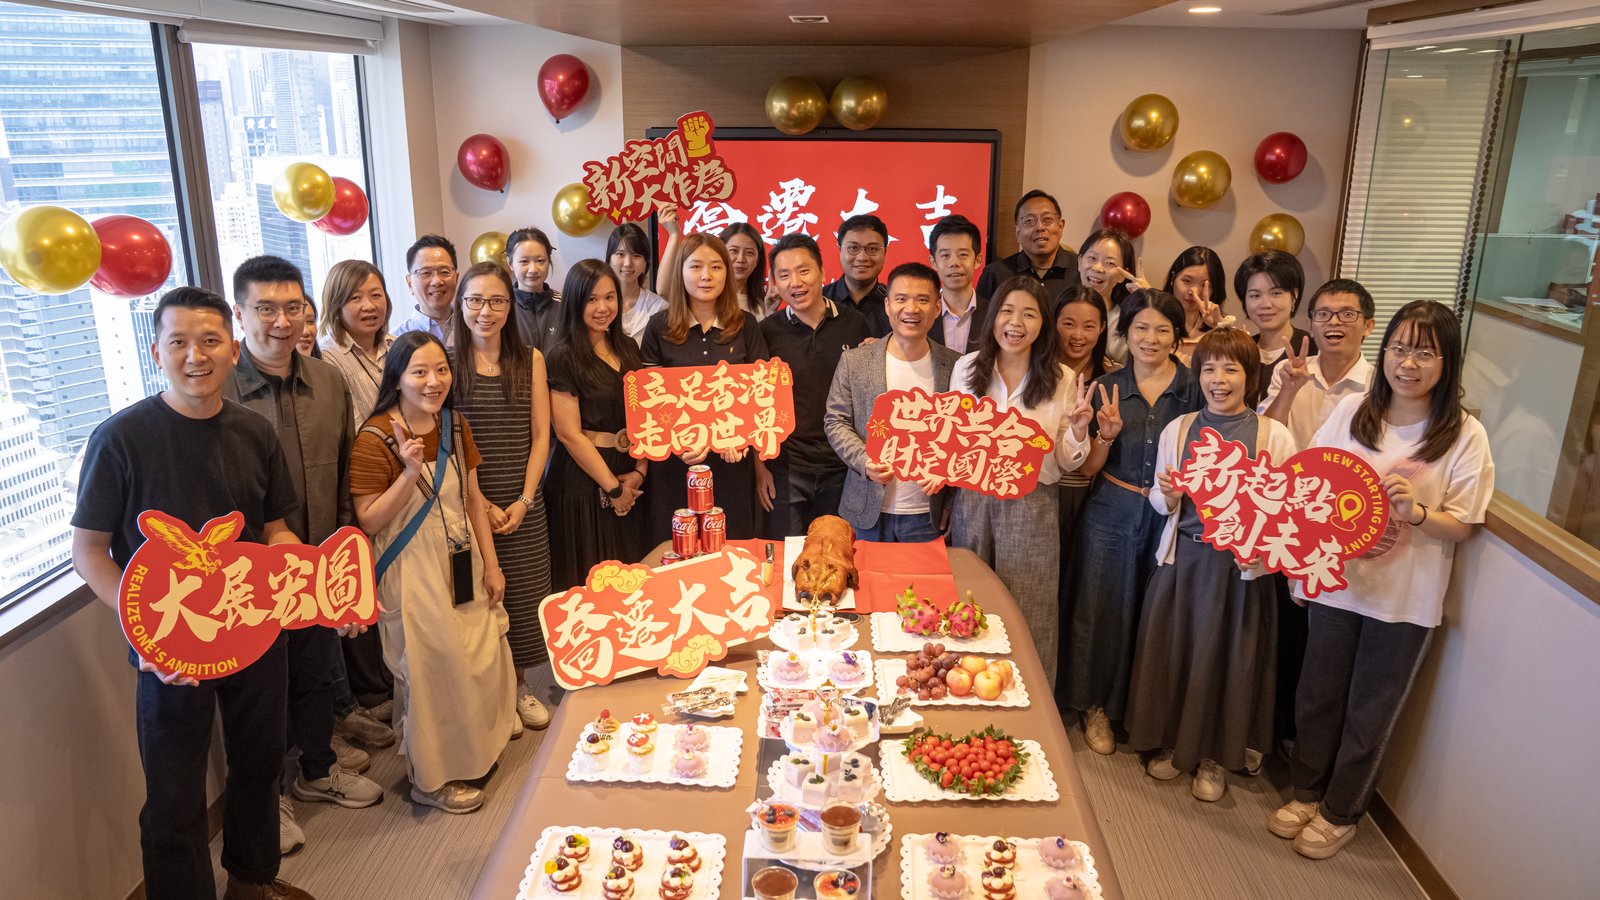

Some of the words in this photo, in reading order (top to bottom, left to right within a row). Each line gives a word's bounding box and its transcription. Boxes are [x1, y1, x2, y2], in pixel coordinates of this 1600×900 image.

[587, 134, 688, 212] 新空間
[639, 364, 776, 412] 立足香港
[633, 407, 784, 457] 走向世界
[889, 391, 1036, 457] 世界共合
[1175, 432, 1336, 524] 新起點
[1323, 452, 1353, 468] NEW
[1352, 464, 1383, 524] STARTING
[1343, 525, 1378, 555] POINT
[126, 564, 149, 625] REALIZE
[149, 533, 375, 643] 大展宏圖
[553, 551, 771, 680] 喬遷大吉
[132, 624, 168, 663] ONE'S
[164, 657, 239, 676] AMBITION
